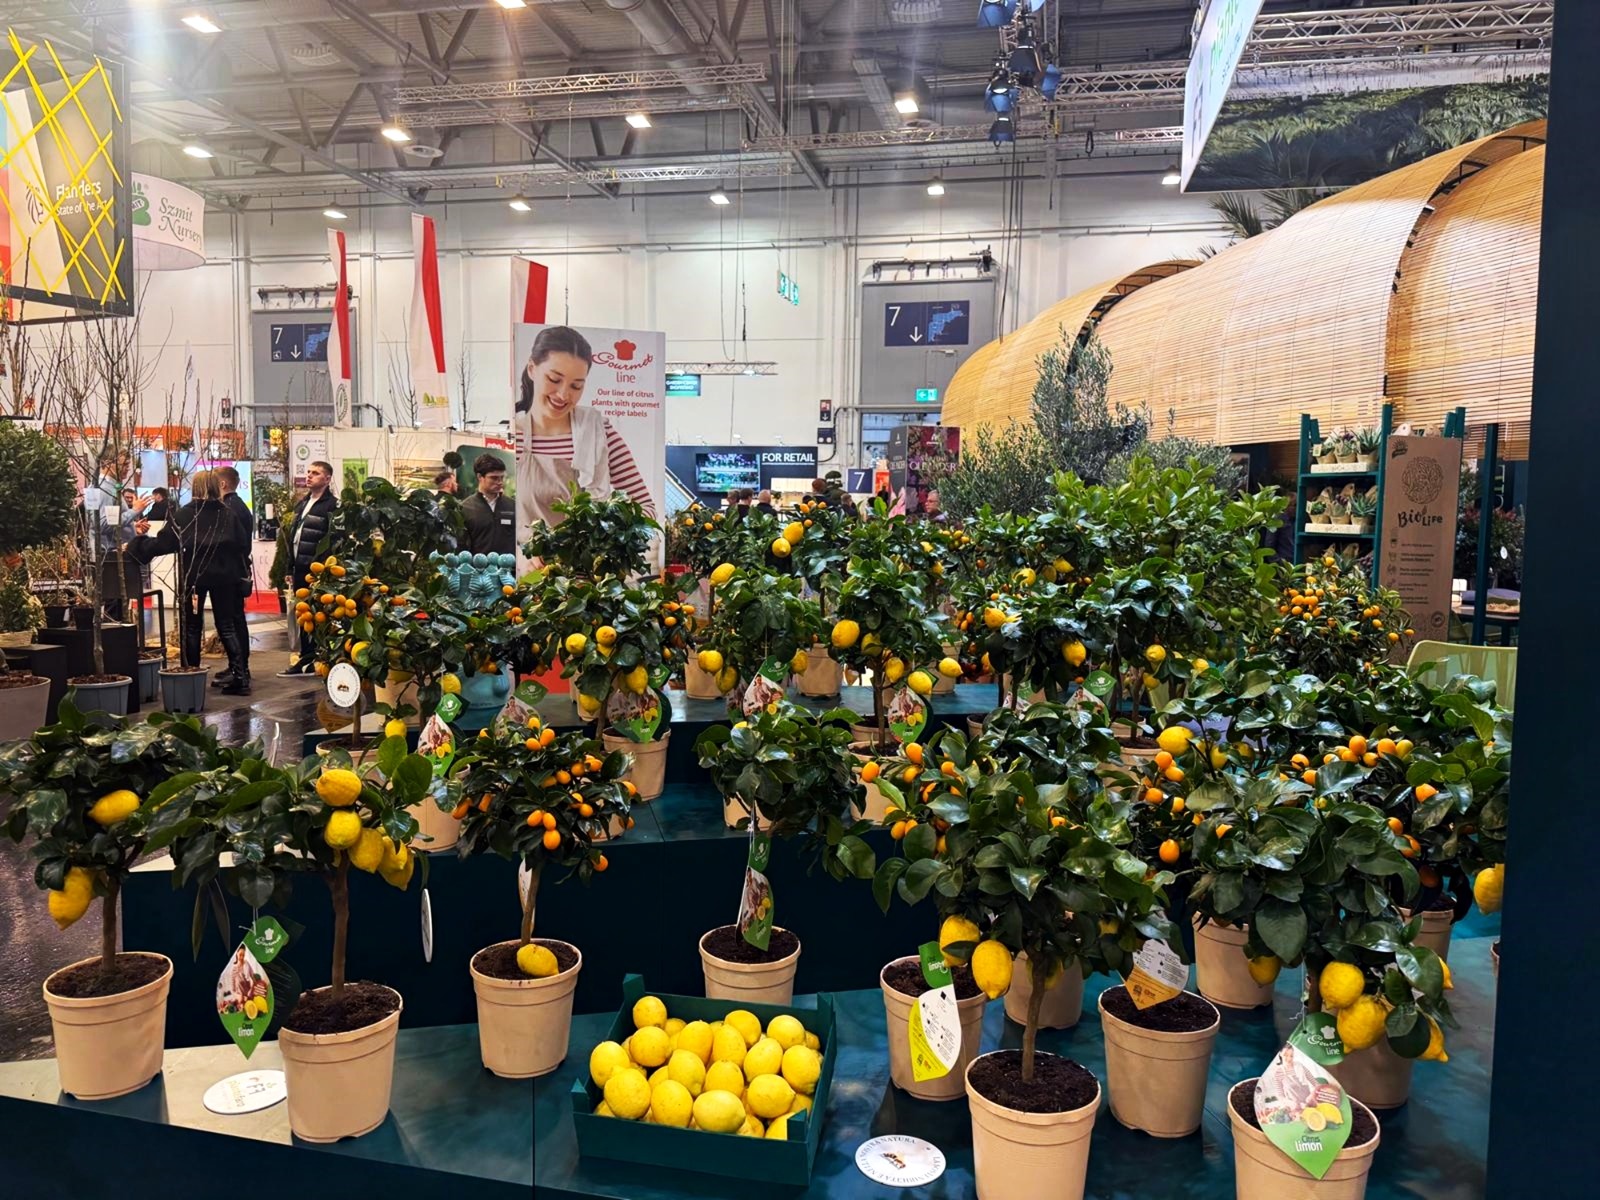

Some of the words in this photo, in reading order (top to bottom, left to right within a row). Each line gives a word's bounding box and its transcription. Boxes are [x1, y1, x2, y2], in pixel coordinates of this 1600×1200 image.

[56, 180, 101, 200] Flanders
[159, 197, 193, 222] Szmit
[888, 306, 901, 327] 7
[273, 327, 283, 345] 7
[591, 352, 653, 370] Gourmet
[616, 371, 636, 383] line
[597, 388, 610, 396] Our
[626, 389, 634, 397] of
[635, 390, 654, 398] citrus
[591, 398, 613, 407] plants
[614, 399, 630, 407] with
[631, 401, 660, 409] gourmet
[604, 409, 625, 417] recipe
[762, 453, 782, 462] FOR
[783, 453, 815, 462] RETAIL
[853, 471, 865, 491] 7
[1307, 1034, 1343, 1047] Gourm
[1325, 1047, 1341, 1056] line
[1295, 1140, 1323, 1152] limon
